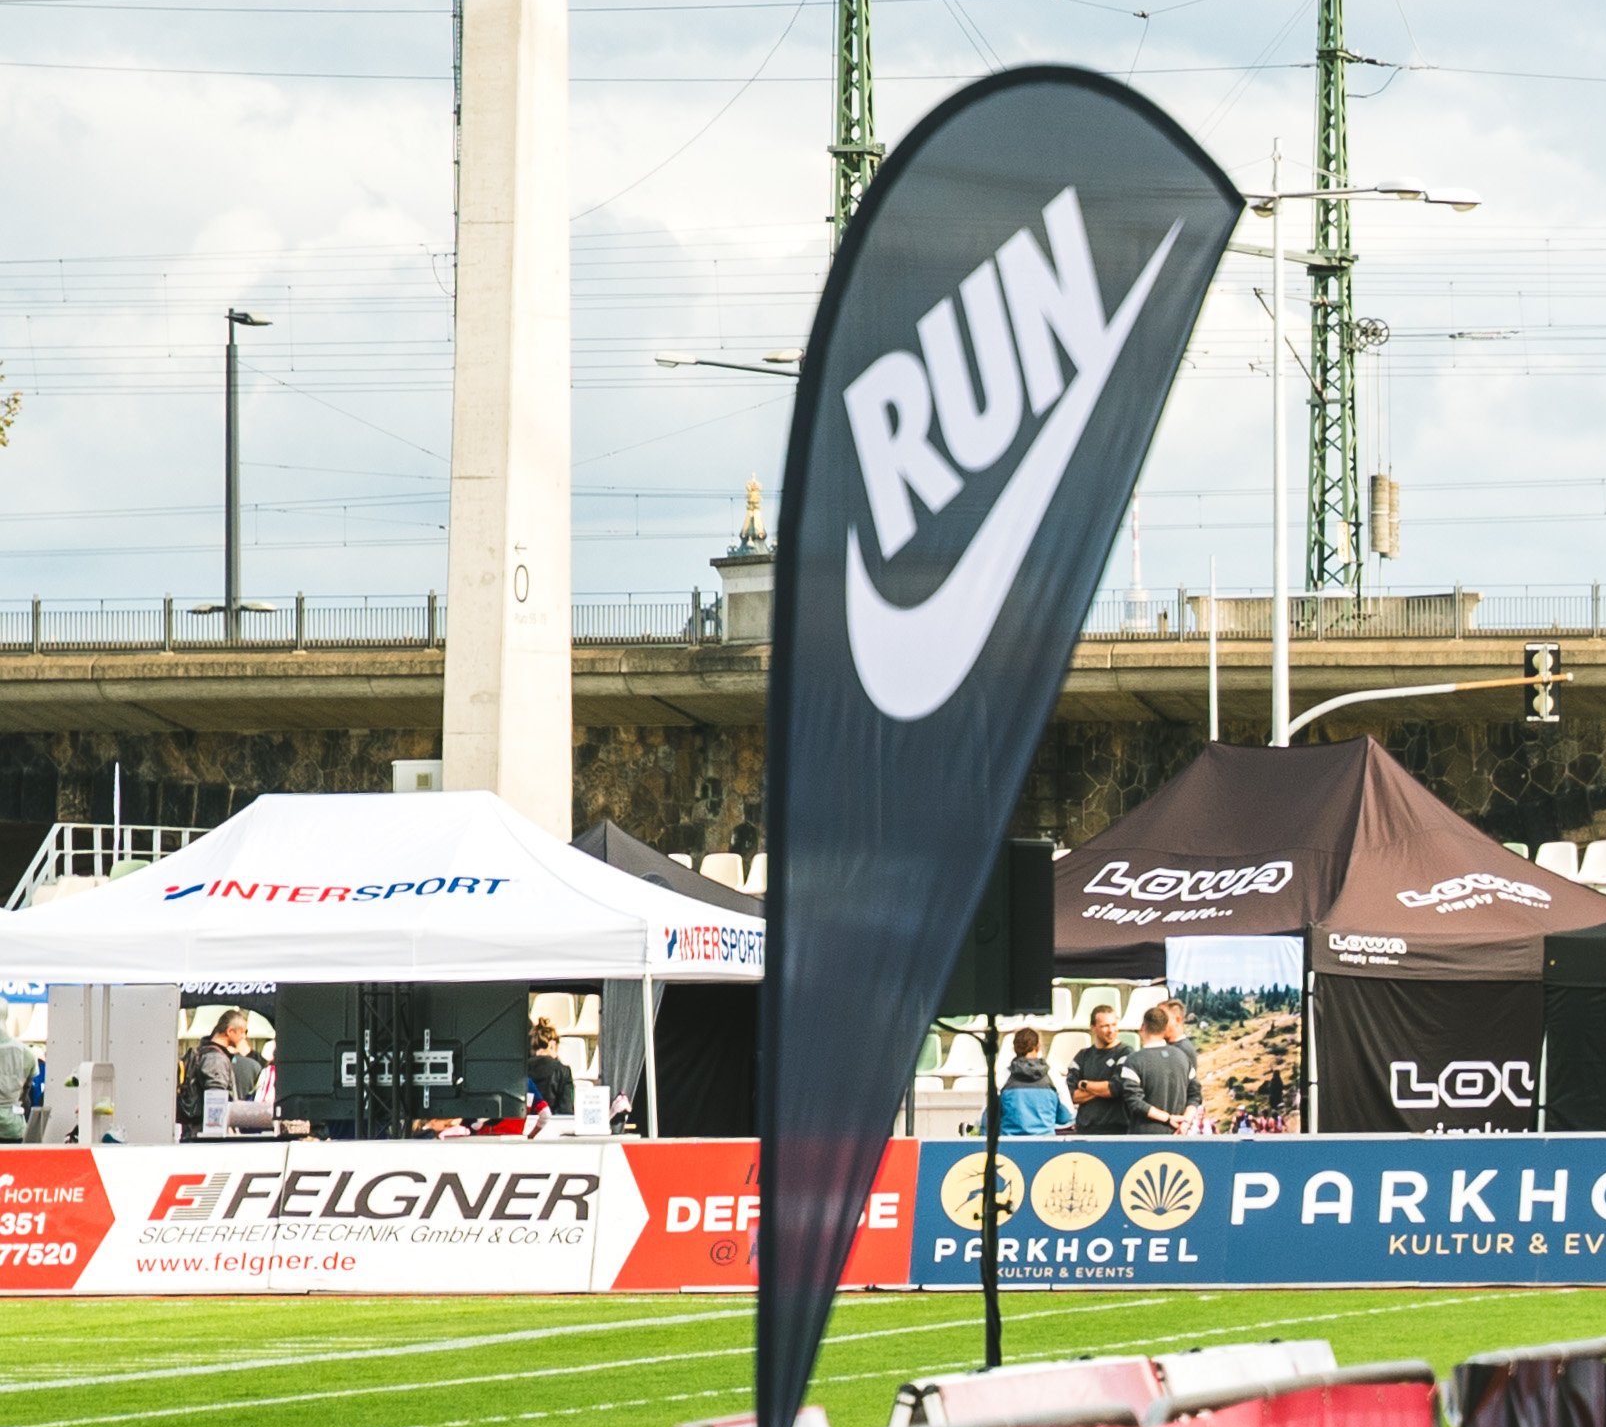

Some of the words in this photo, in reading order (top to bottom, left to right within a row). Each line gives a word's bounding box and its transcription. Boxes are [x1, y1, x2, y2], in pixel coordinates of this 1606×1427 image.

[842, 185, 1110, 562] RUN
[206, 876, 511, 903] INTERSPORT
[1083, 861, 1294, 903] LOWA
[1082, 902, 1162, 926] simply
[679, 926, 764, 965] INTERSPORT
[1328, 933, 1408, 955] LOWA
[1338, 952, 1367, 966] simply
[4, 1187, 84, 1203] HOTLINE
[222, 1170, 600, 1221] FELGNER
[138, 1223, 405, 1245] SICHERHEITSTECHNIK
[410, 1224, 483, 1244] GmbH
[487, 1226, 503, 1244] &
[508, 1226, 541, 1244] Co.
[548, 1226, 585, 1245] KG
[1389, 1233, 1515, 1256] KULTUR
[1529, 1233, 1549, 1255] &
[933, 1237, 1199, 1263] PARKHOTEL
[136, 1251, 356, 1276] www.felgner.de
[1059, 1267, 1069, 1278] &
[1075, 1267, 1134, 1278] EVENTS
